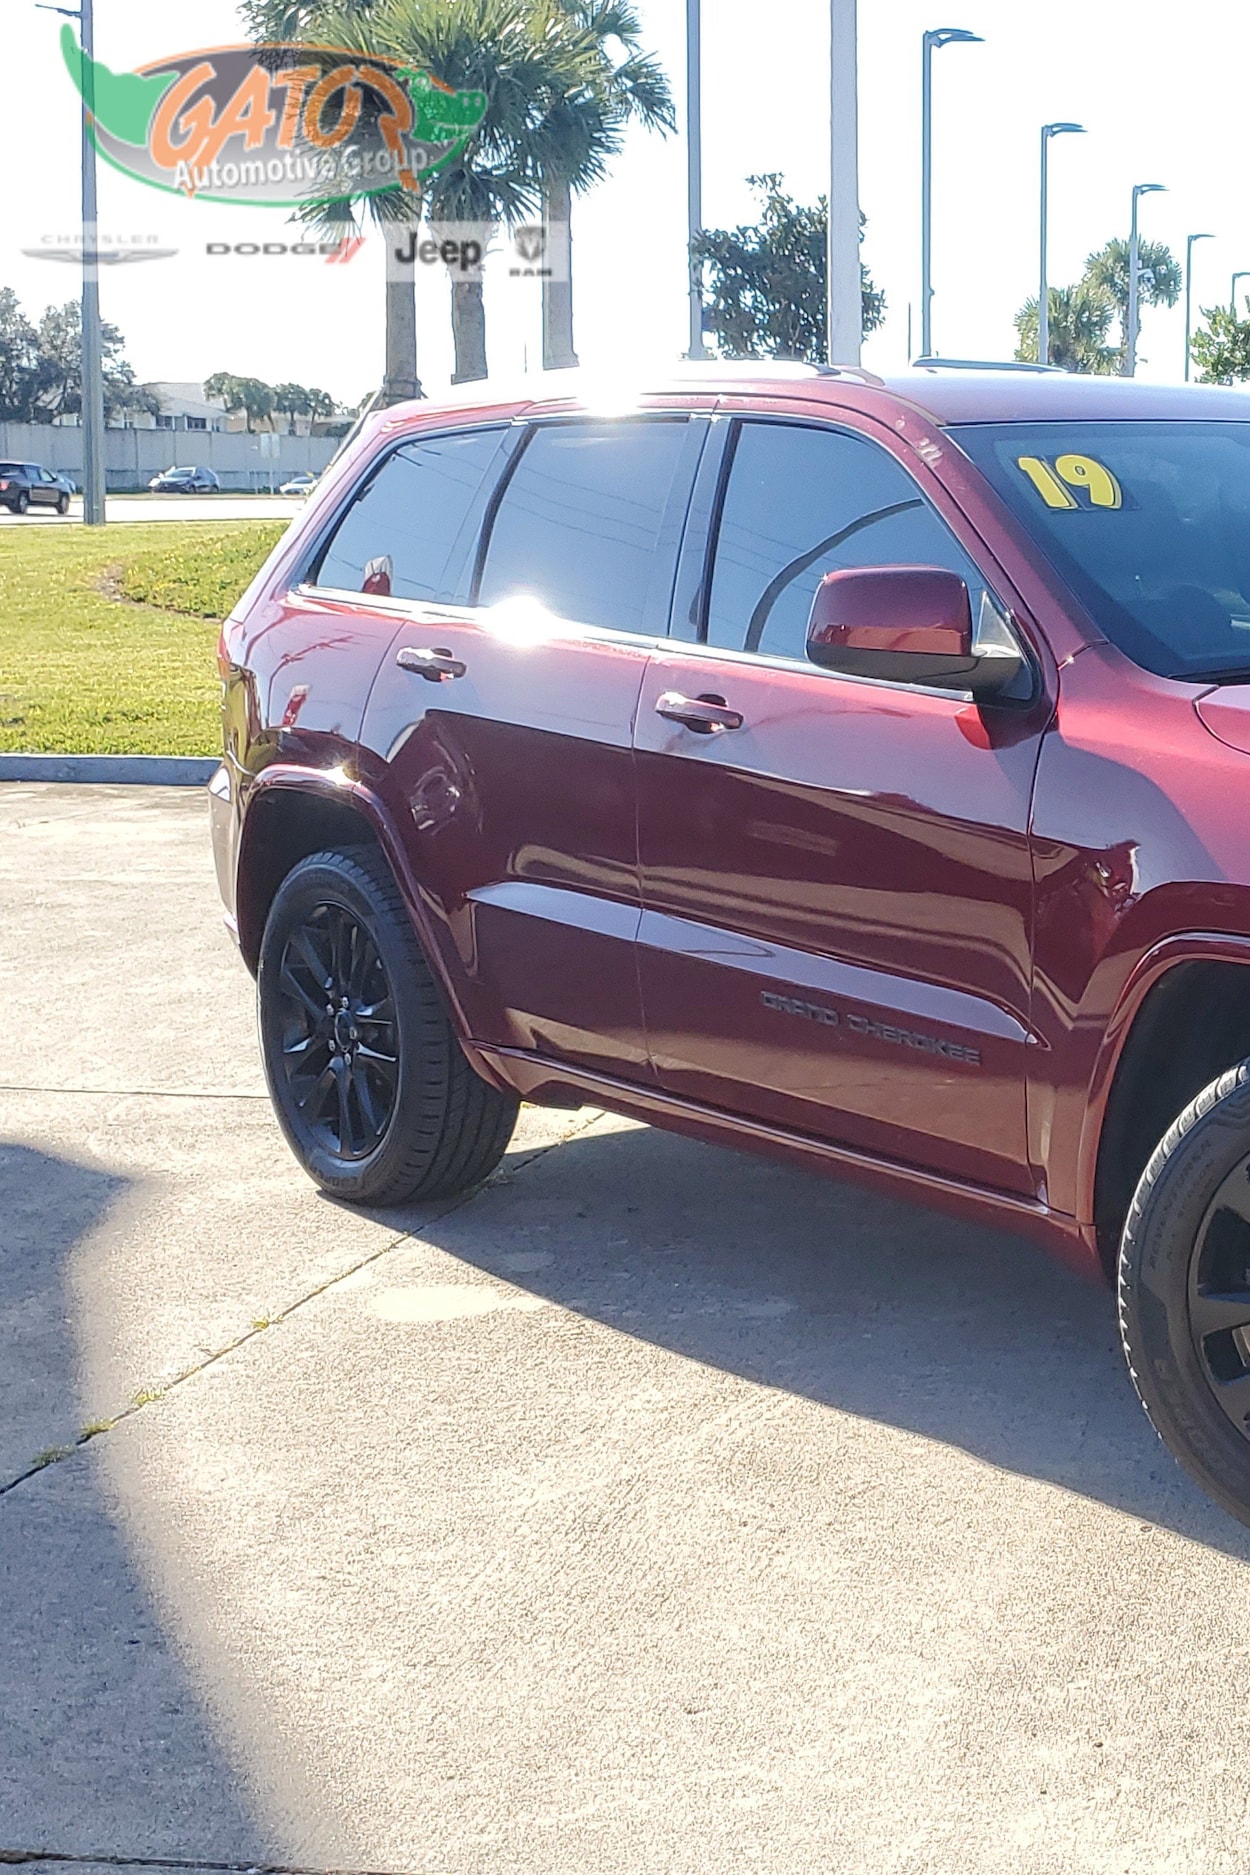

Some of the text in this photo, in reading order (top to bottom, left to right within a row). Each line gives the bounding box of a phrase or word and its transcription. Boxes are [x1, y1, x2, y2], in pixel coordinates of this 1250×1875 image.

[1018, 454, 1122, 509] 19
[761, 990, 981, 1066] GRAND CHEROKEE
